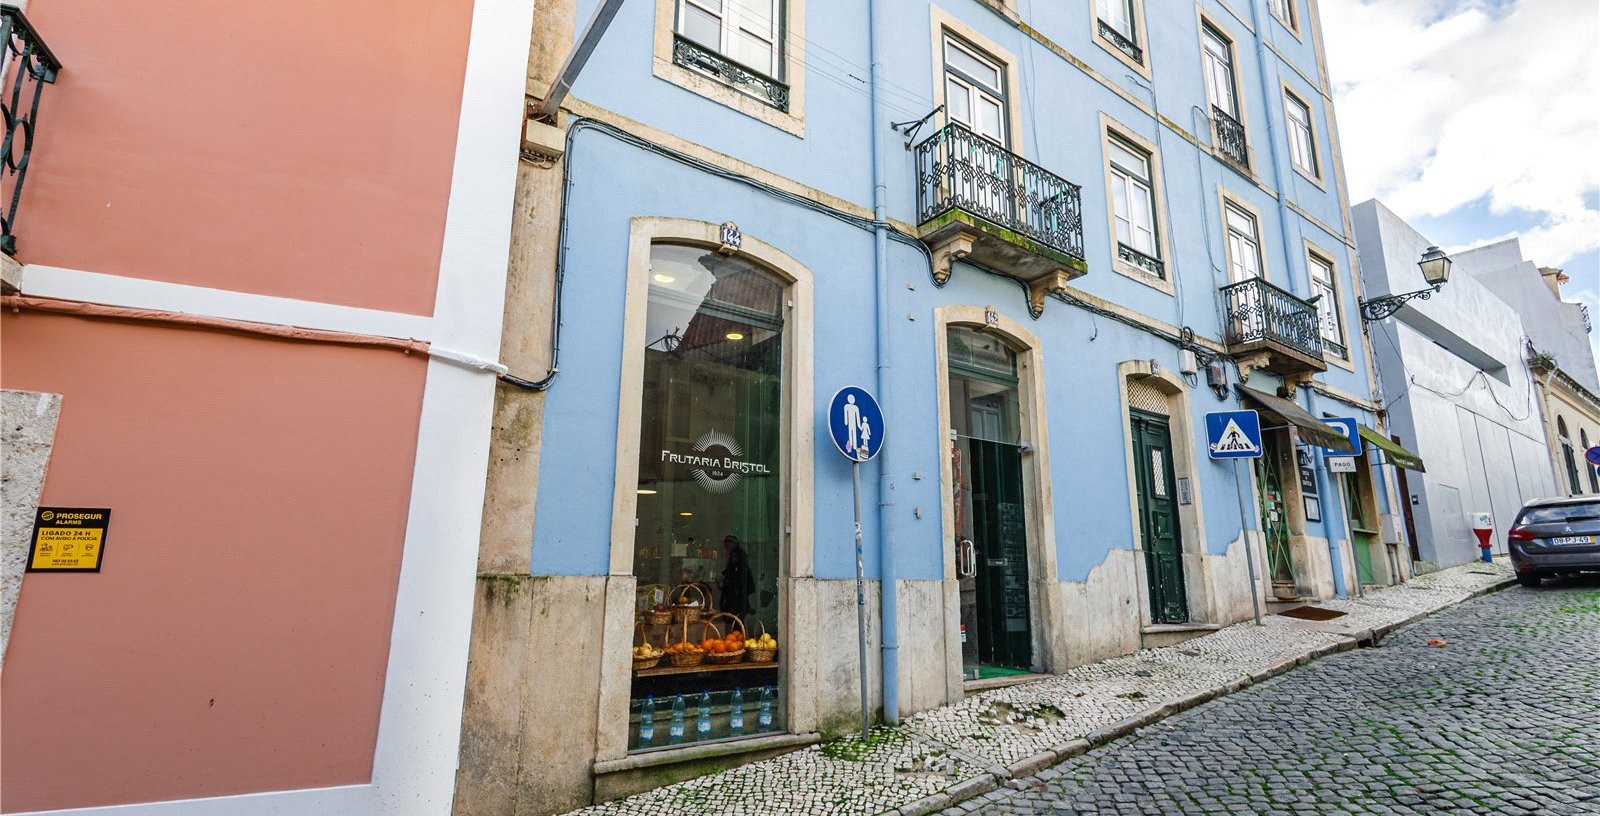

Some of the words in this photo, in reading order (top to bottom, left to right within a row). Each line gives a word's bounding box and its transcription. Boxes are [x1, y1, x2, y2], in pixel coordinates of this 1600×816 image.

[723, 228, 741, 246] 144
[661, 450, 721, 468] FRUTARIA
[723, 457, 771, 474] BRISTOL
